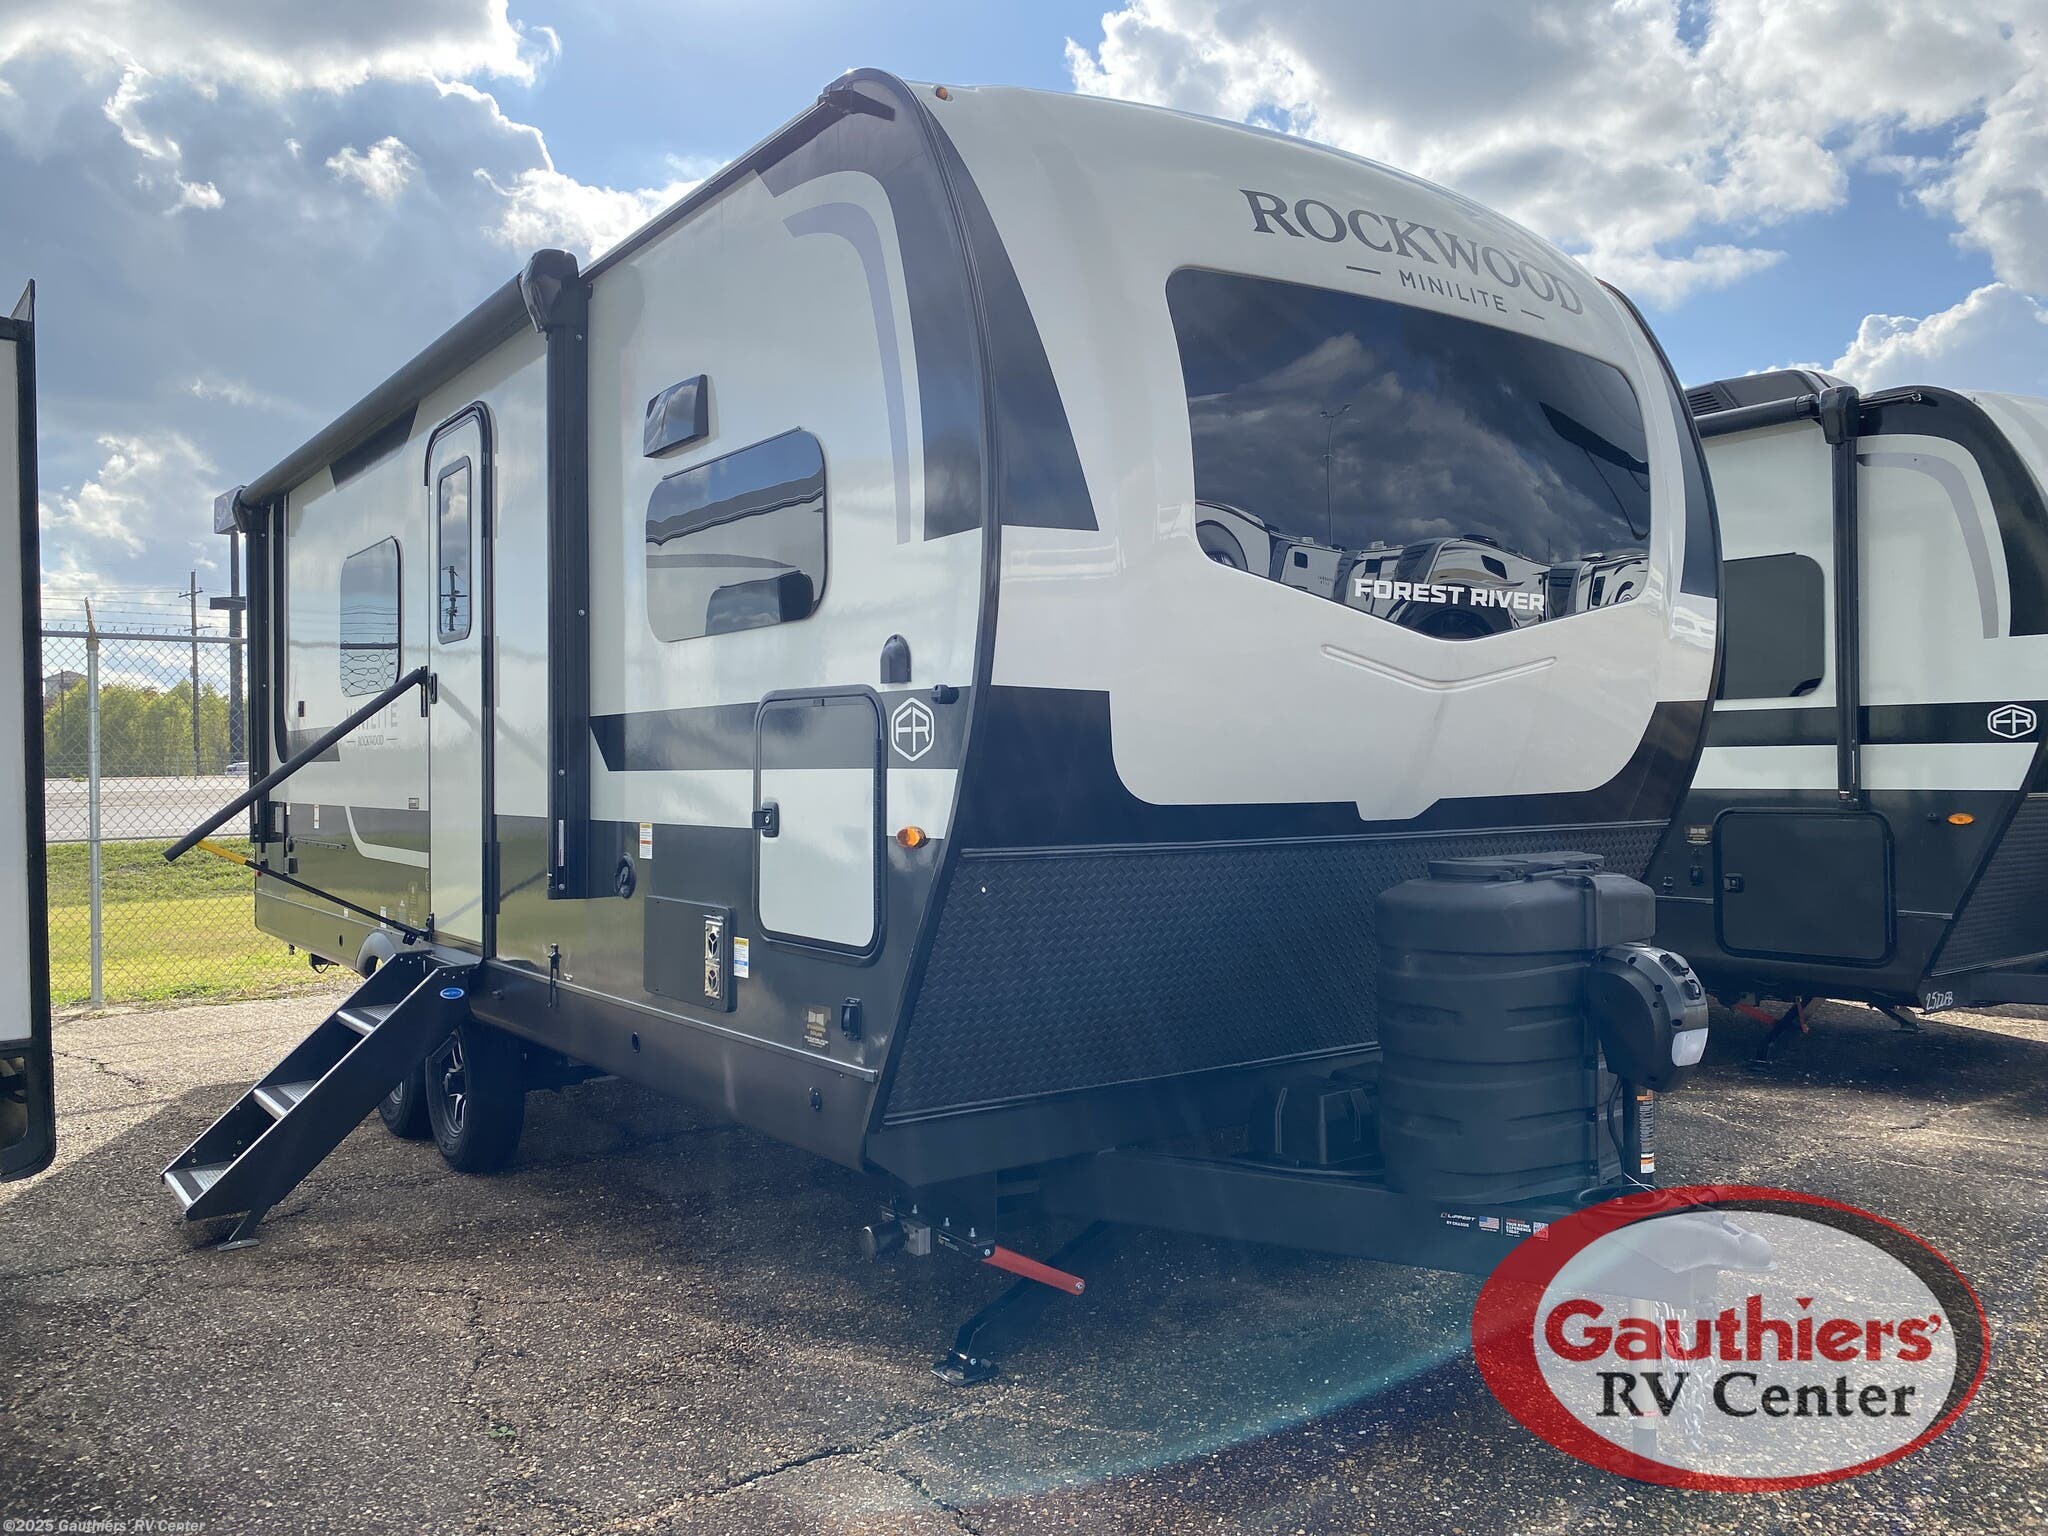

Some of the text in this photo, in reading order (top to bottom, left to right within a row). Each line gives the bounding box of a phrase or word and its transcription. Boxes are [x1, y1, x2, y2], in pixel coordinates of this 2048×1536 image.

[1239, 188, 1584, 316] ROCKWOOD
[1399, 269, 1508, 313] MINILITE
[1354, 578, 1545, 611] FOREST RIVER
